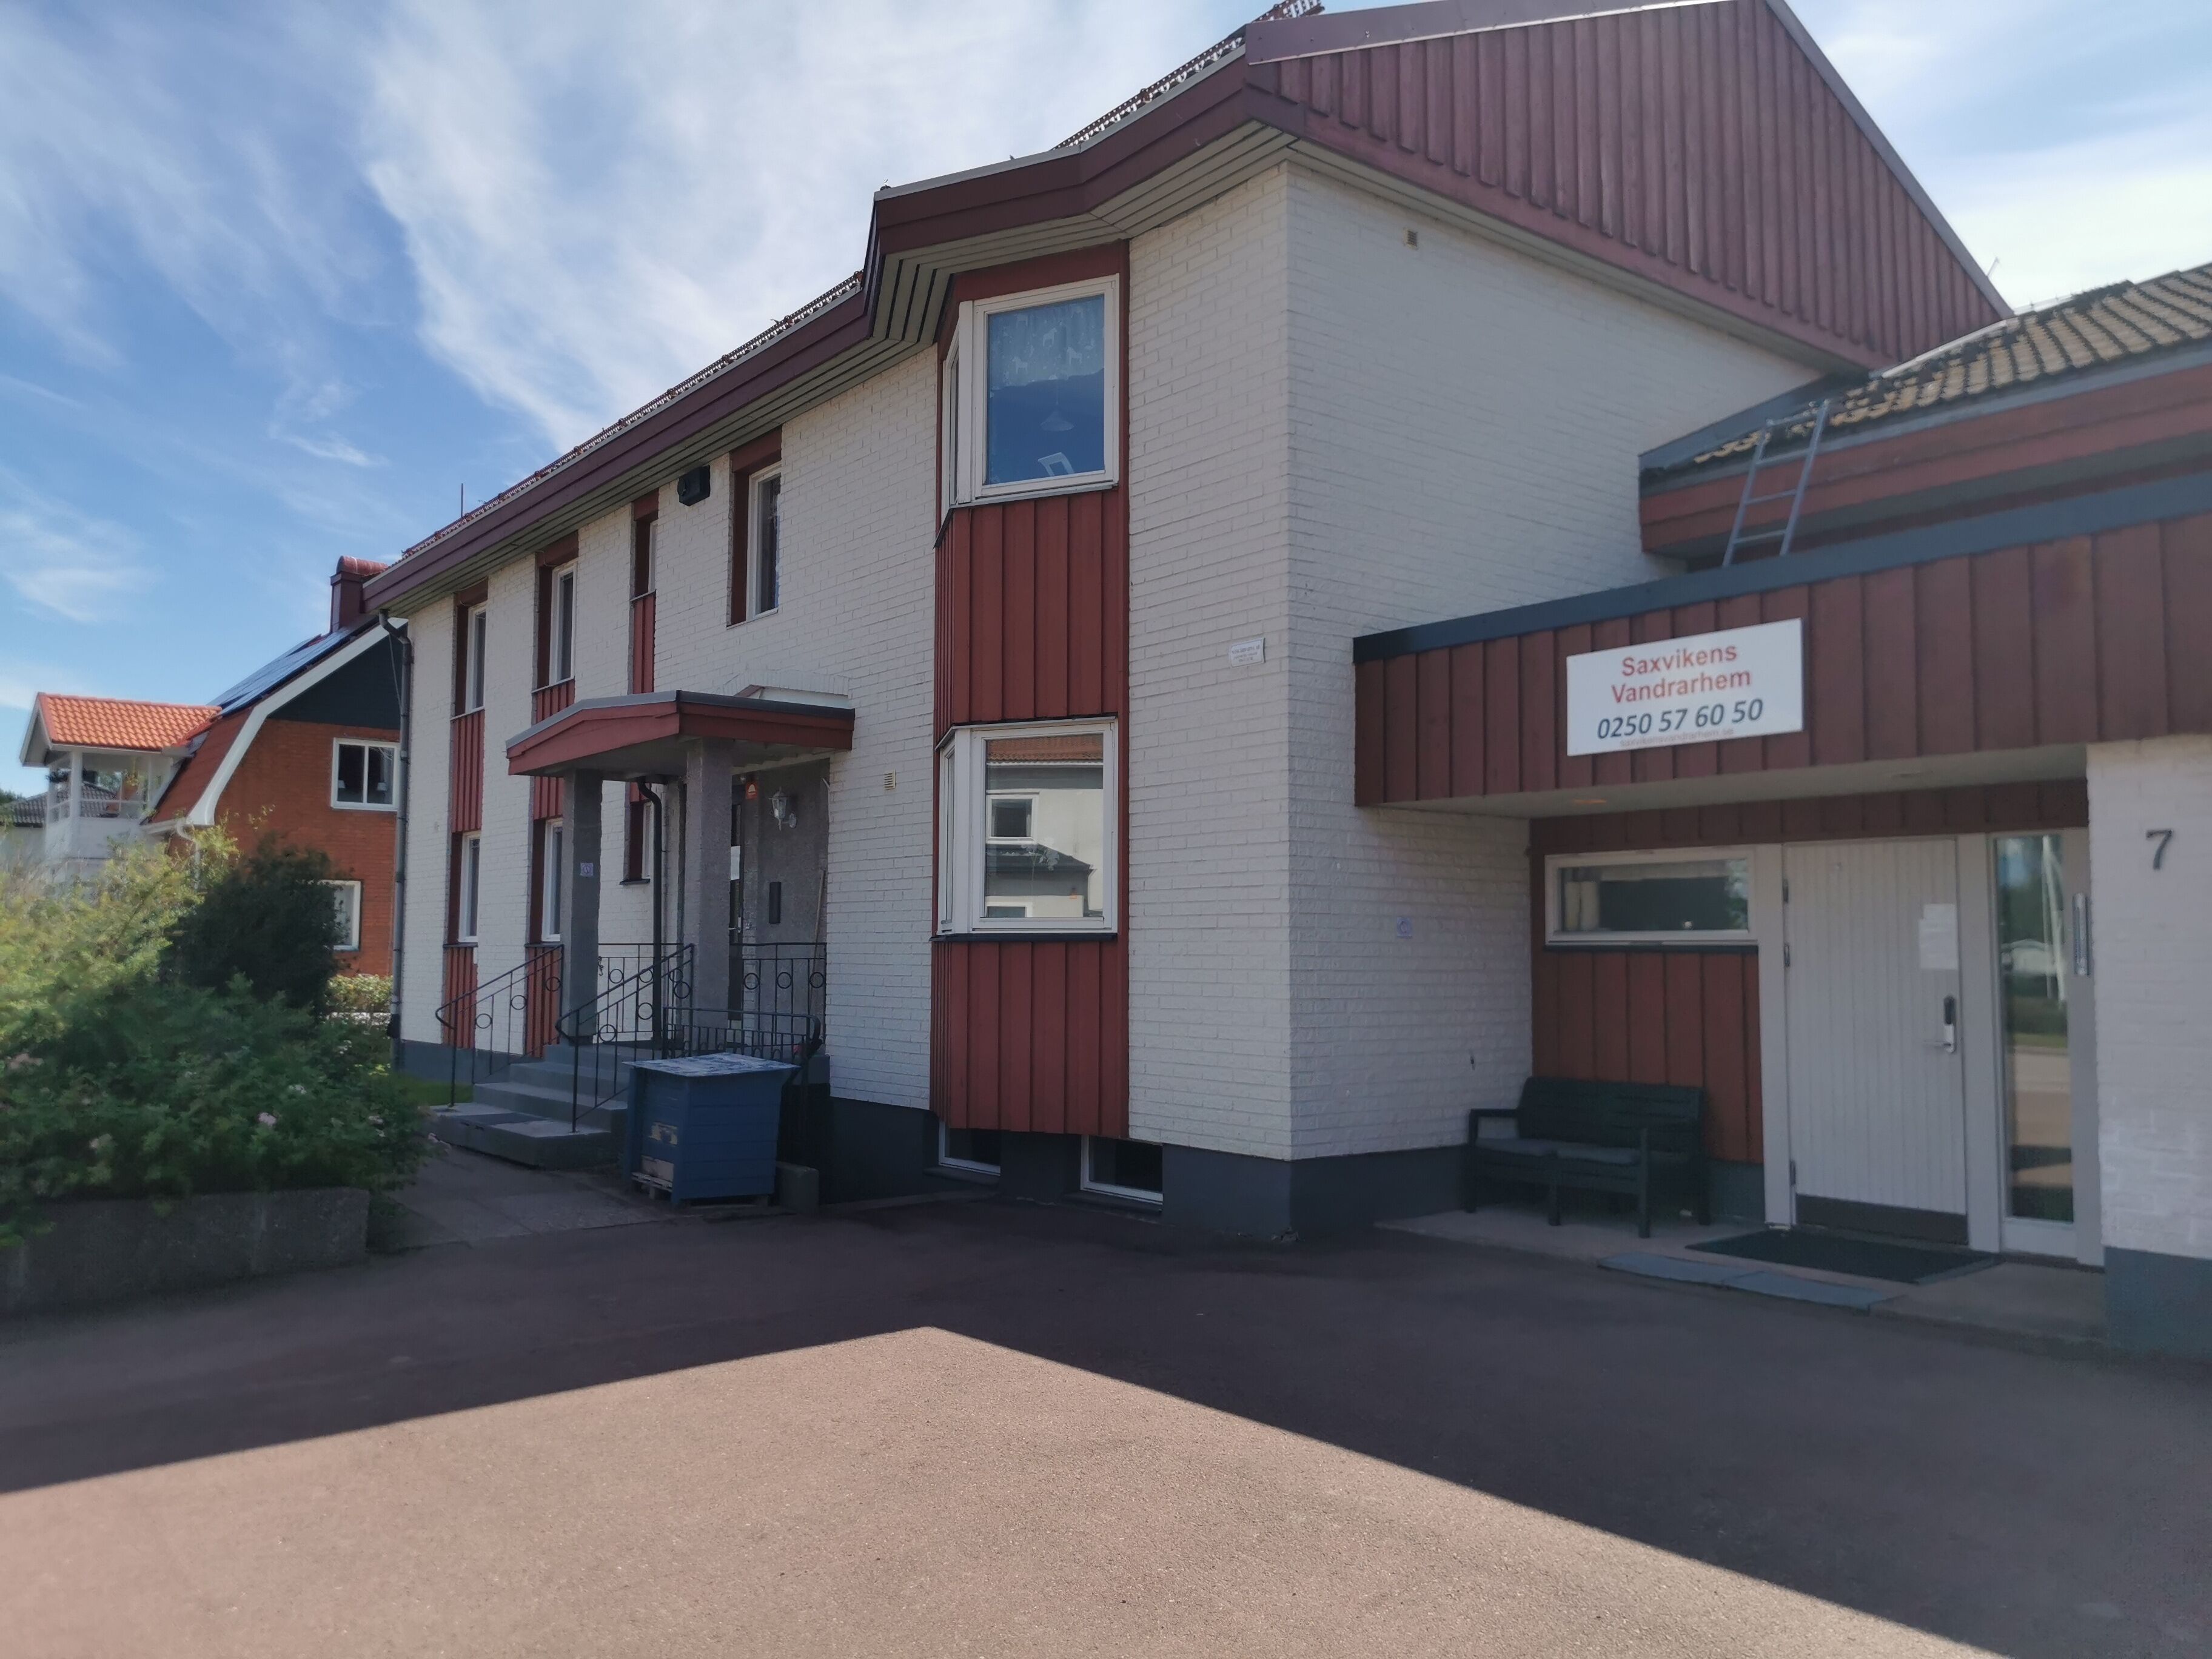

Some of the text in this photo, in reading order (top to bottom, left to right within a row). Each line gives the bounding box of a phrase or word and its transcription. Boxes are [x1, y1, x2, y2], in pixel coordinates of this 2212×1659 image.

[1621, 645, 1738, 676] Saxvikens
[1611, 669, 1751, 703] Vandrarhem
[1597, 699, 1763, 739] 0250 57 60 50
[2146, 829, 2173, 870] 7
